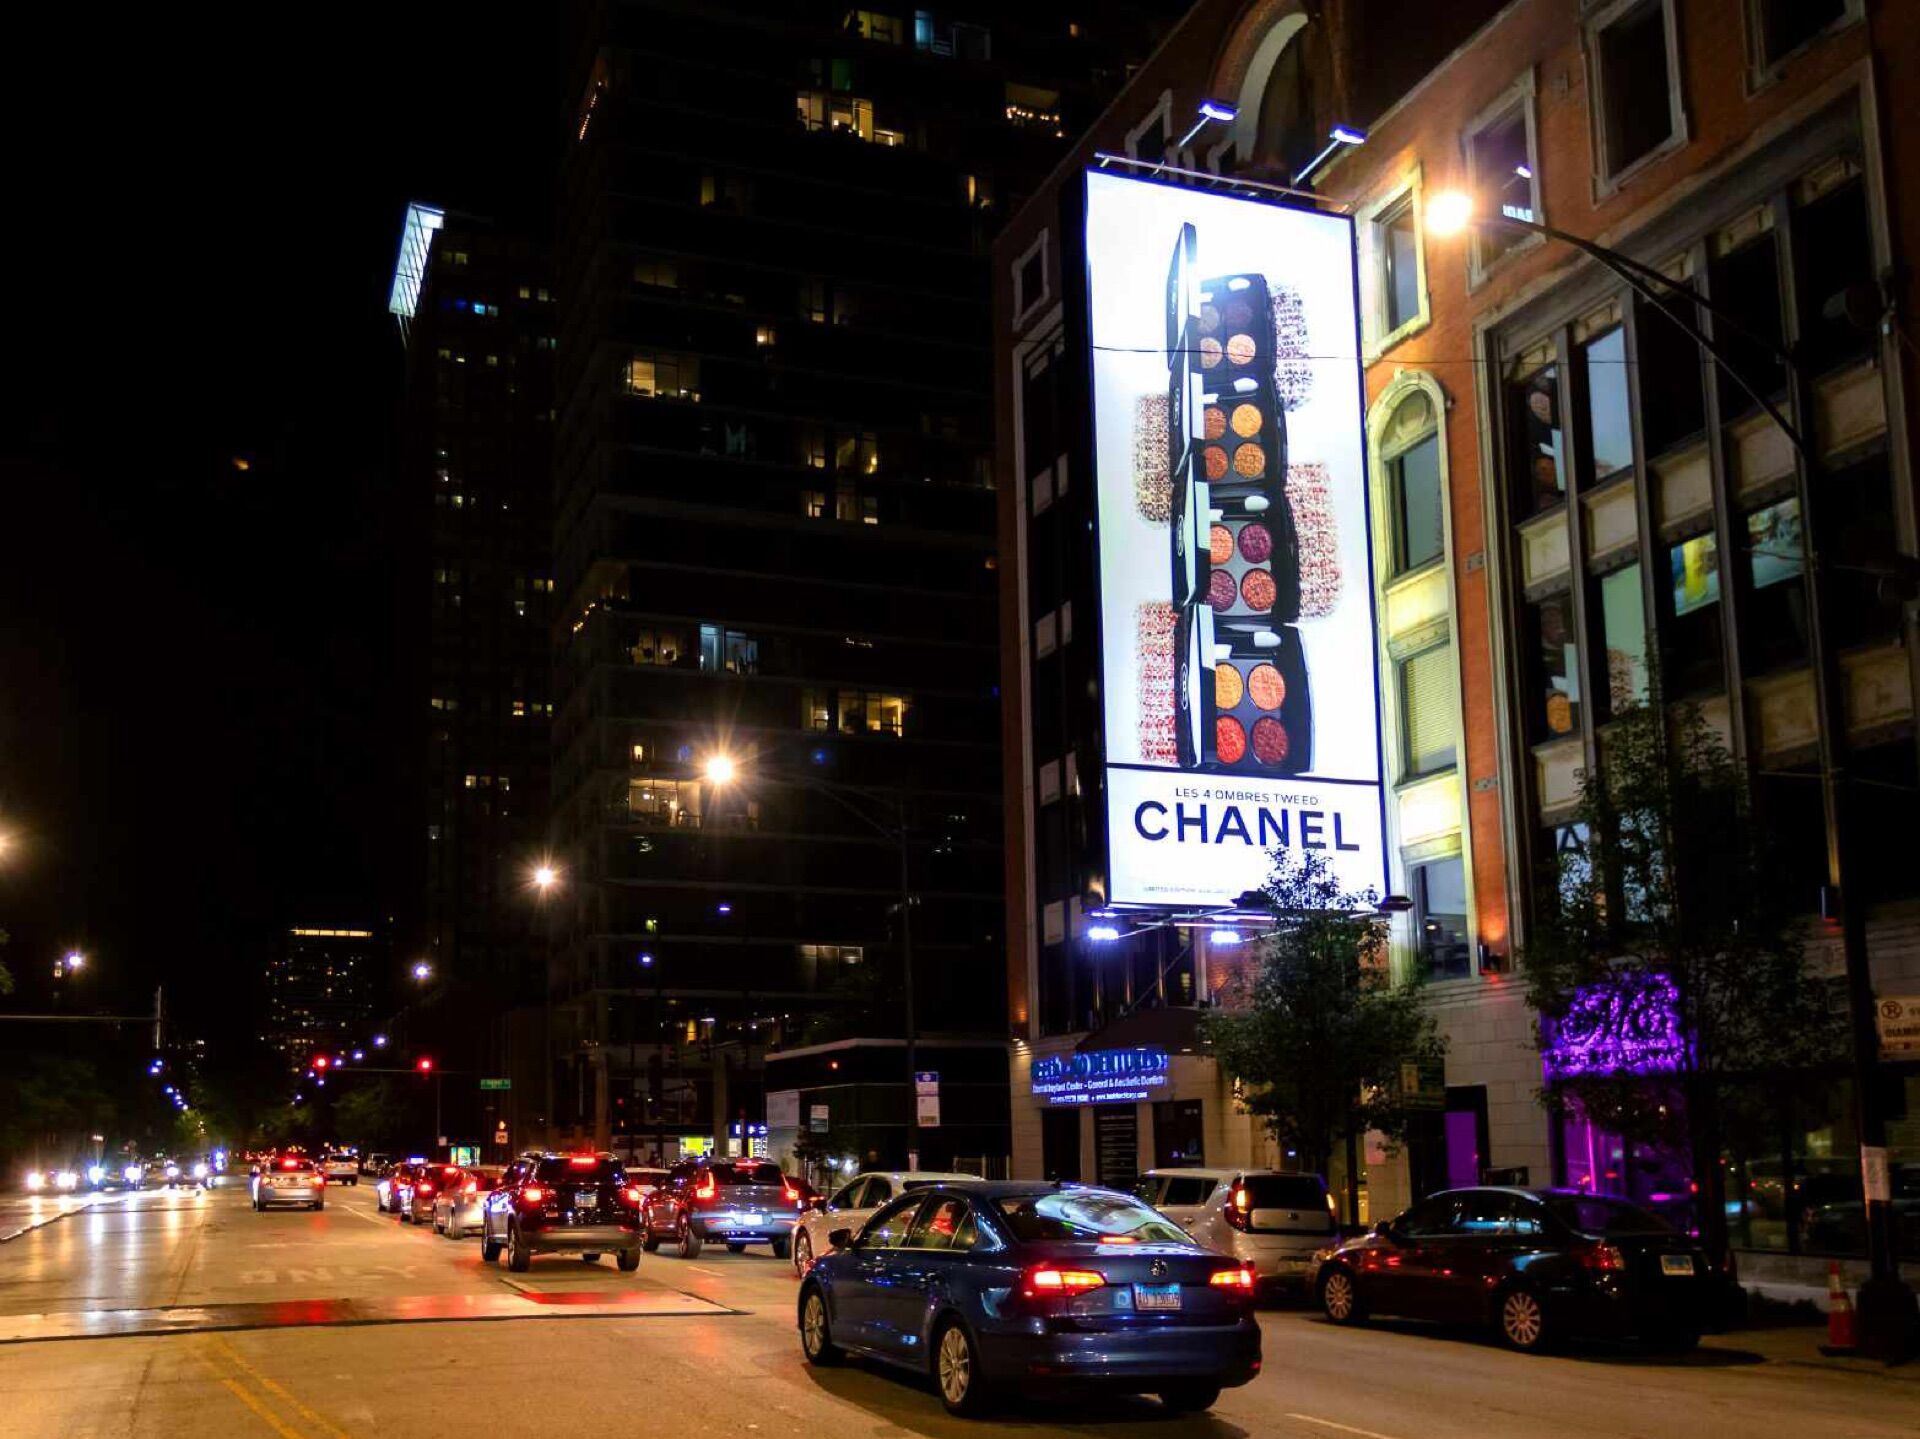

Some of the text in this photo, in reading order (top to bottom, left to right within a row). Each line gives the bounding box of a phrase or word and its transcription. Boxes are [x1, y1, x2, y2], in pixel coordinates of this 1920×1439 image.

[1175, 787, 1319, 806] LES 4 OMBRES TWEED
[1134, 800, 1360, 852] CHANEL
[240, 1265, 418, 1284] ONLY
